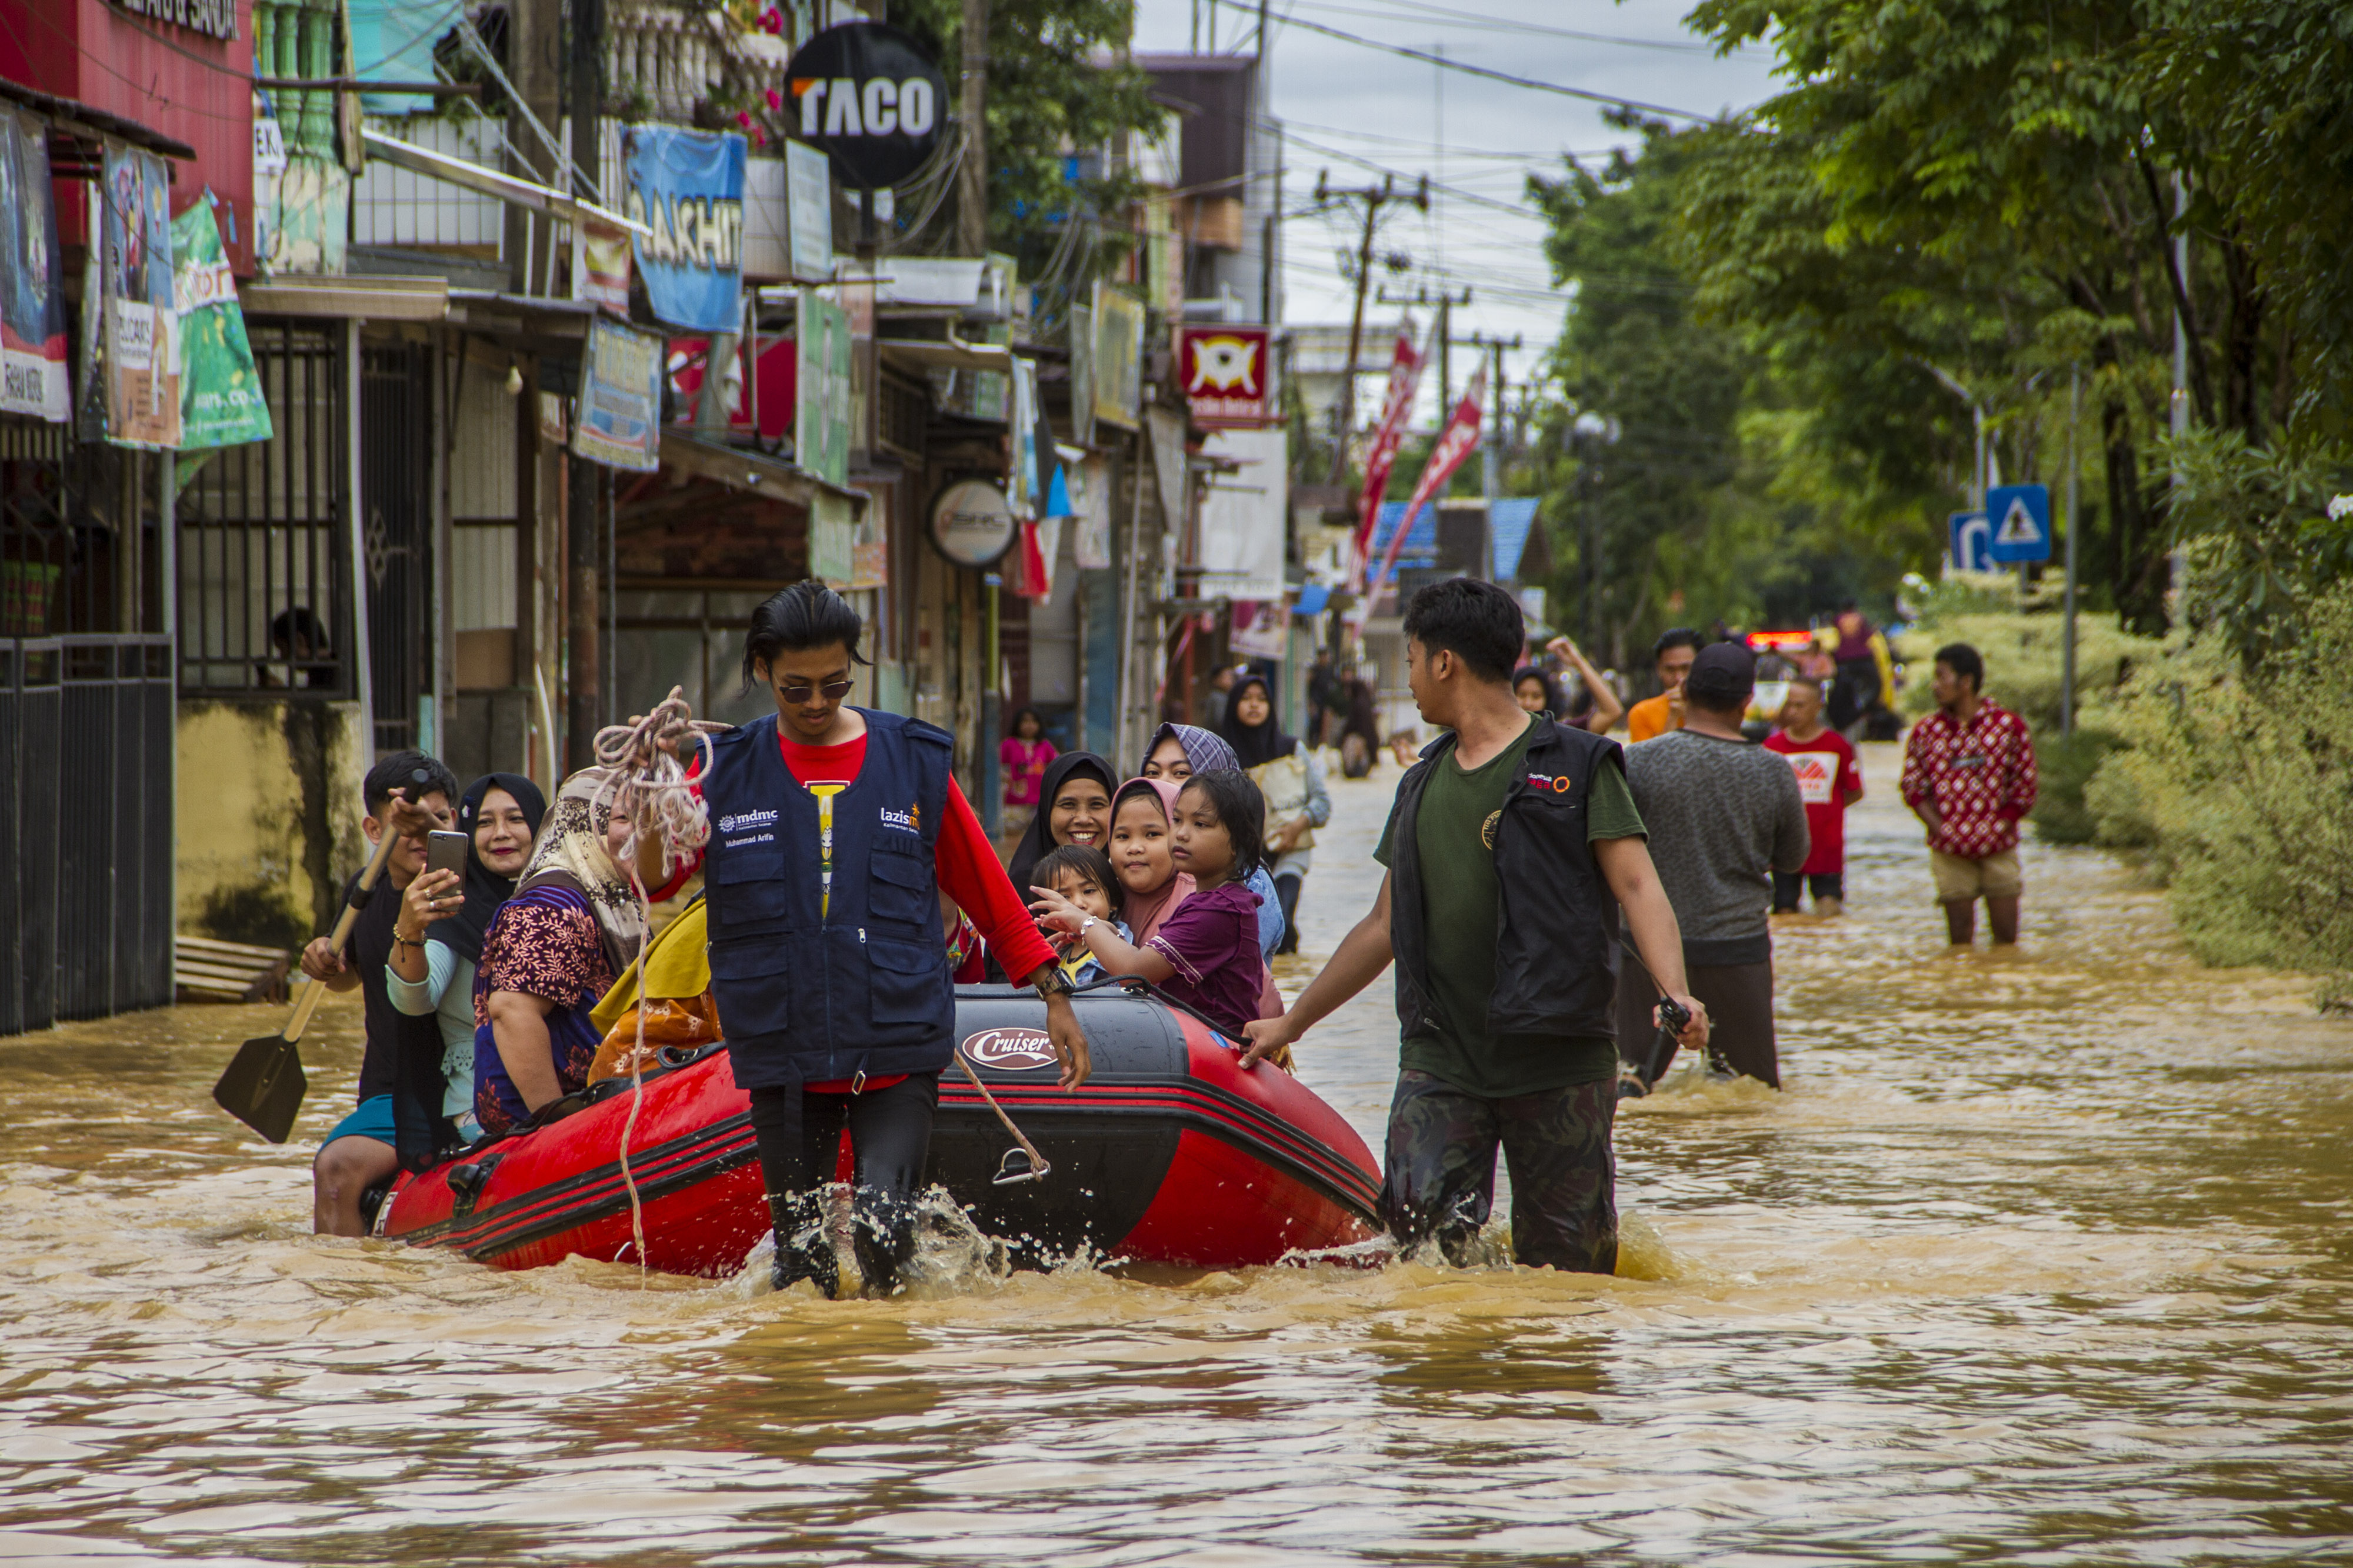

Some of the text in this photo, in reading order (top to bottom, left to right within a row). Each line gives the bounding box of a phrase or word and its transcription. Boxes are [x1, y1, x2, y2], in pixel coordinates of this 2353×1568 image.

[792, 77, 934, 136] TACO
[737, 809, 778, 823] mdmc
[725, 833, 774, 848] Muhammad Arifin
[974, 1032, 1052, 1062] Cruiser
